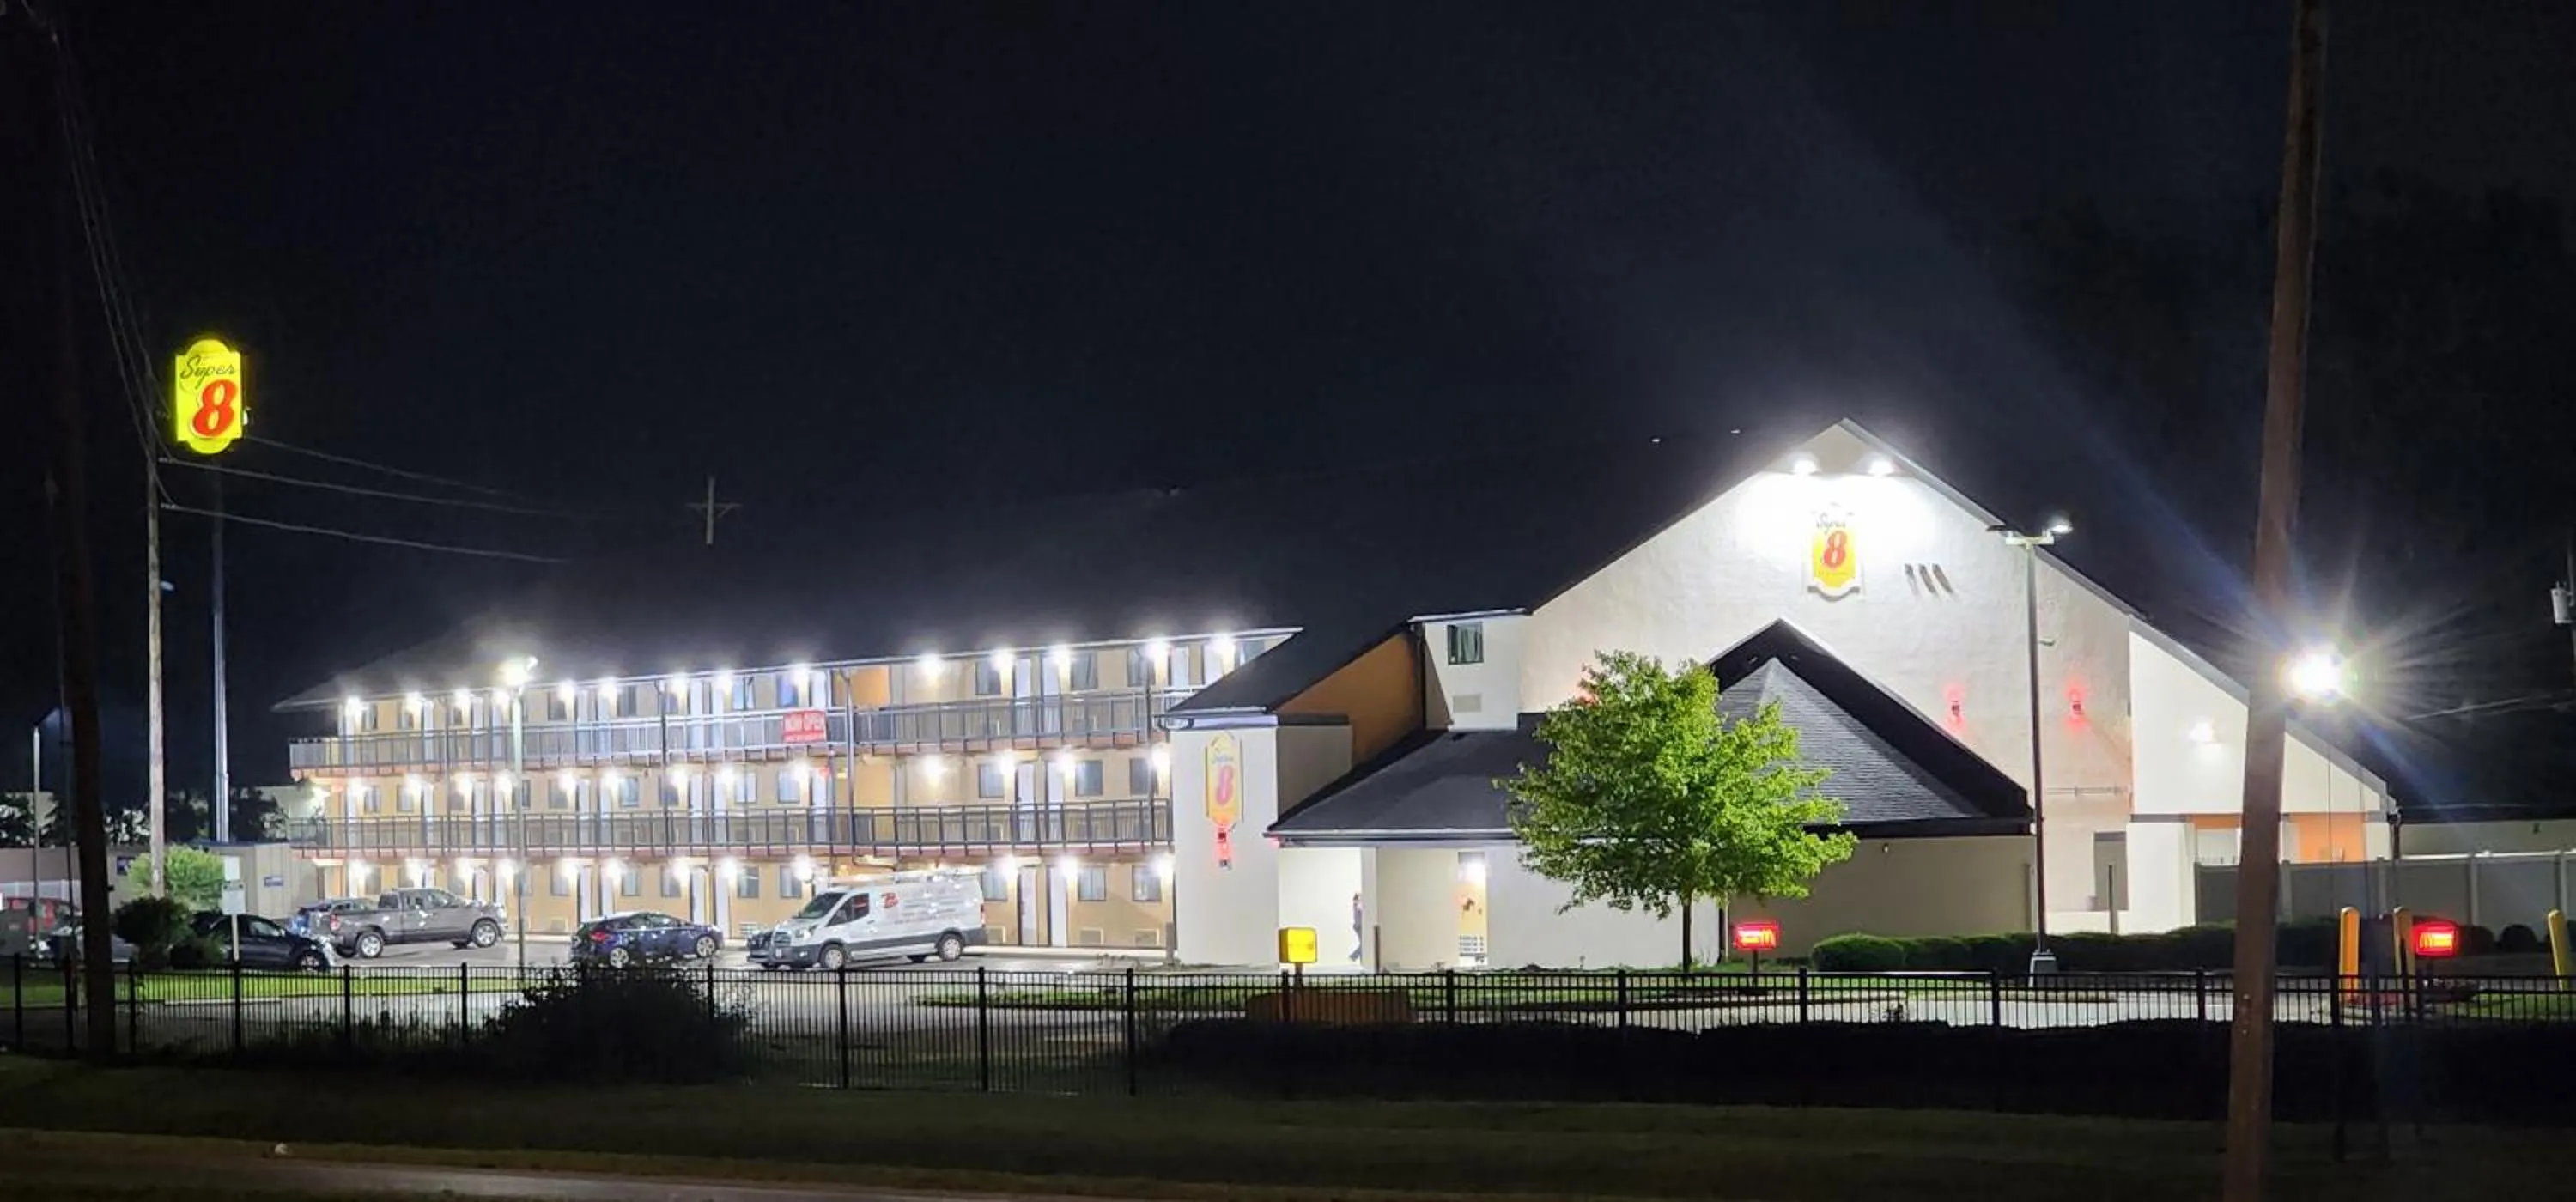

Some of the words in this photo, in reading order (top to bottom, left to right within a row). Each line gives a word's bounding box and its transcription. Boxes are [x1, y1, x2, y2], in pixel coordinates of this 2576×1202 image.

[179, 355, 234, 390] Super
[192, 379, 237, 437] 8
[1823, 531, 1847, 568] 8
[1216, 764, 1234, 804] 8
